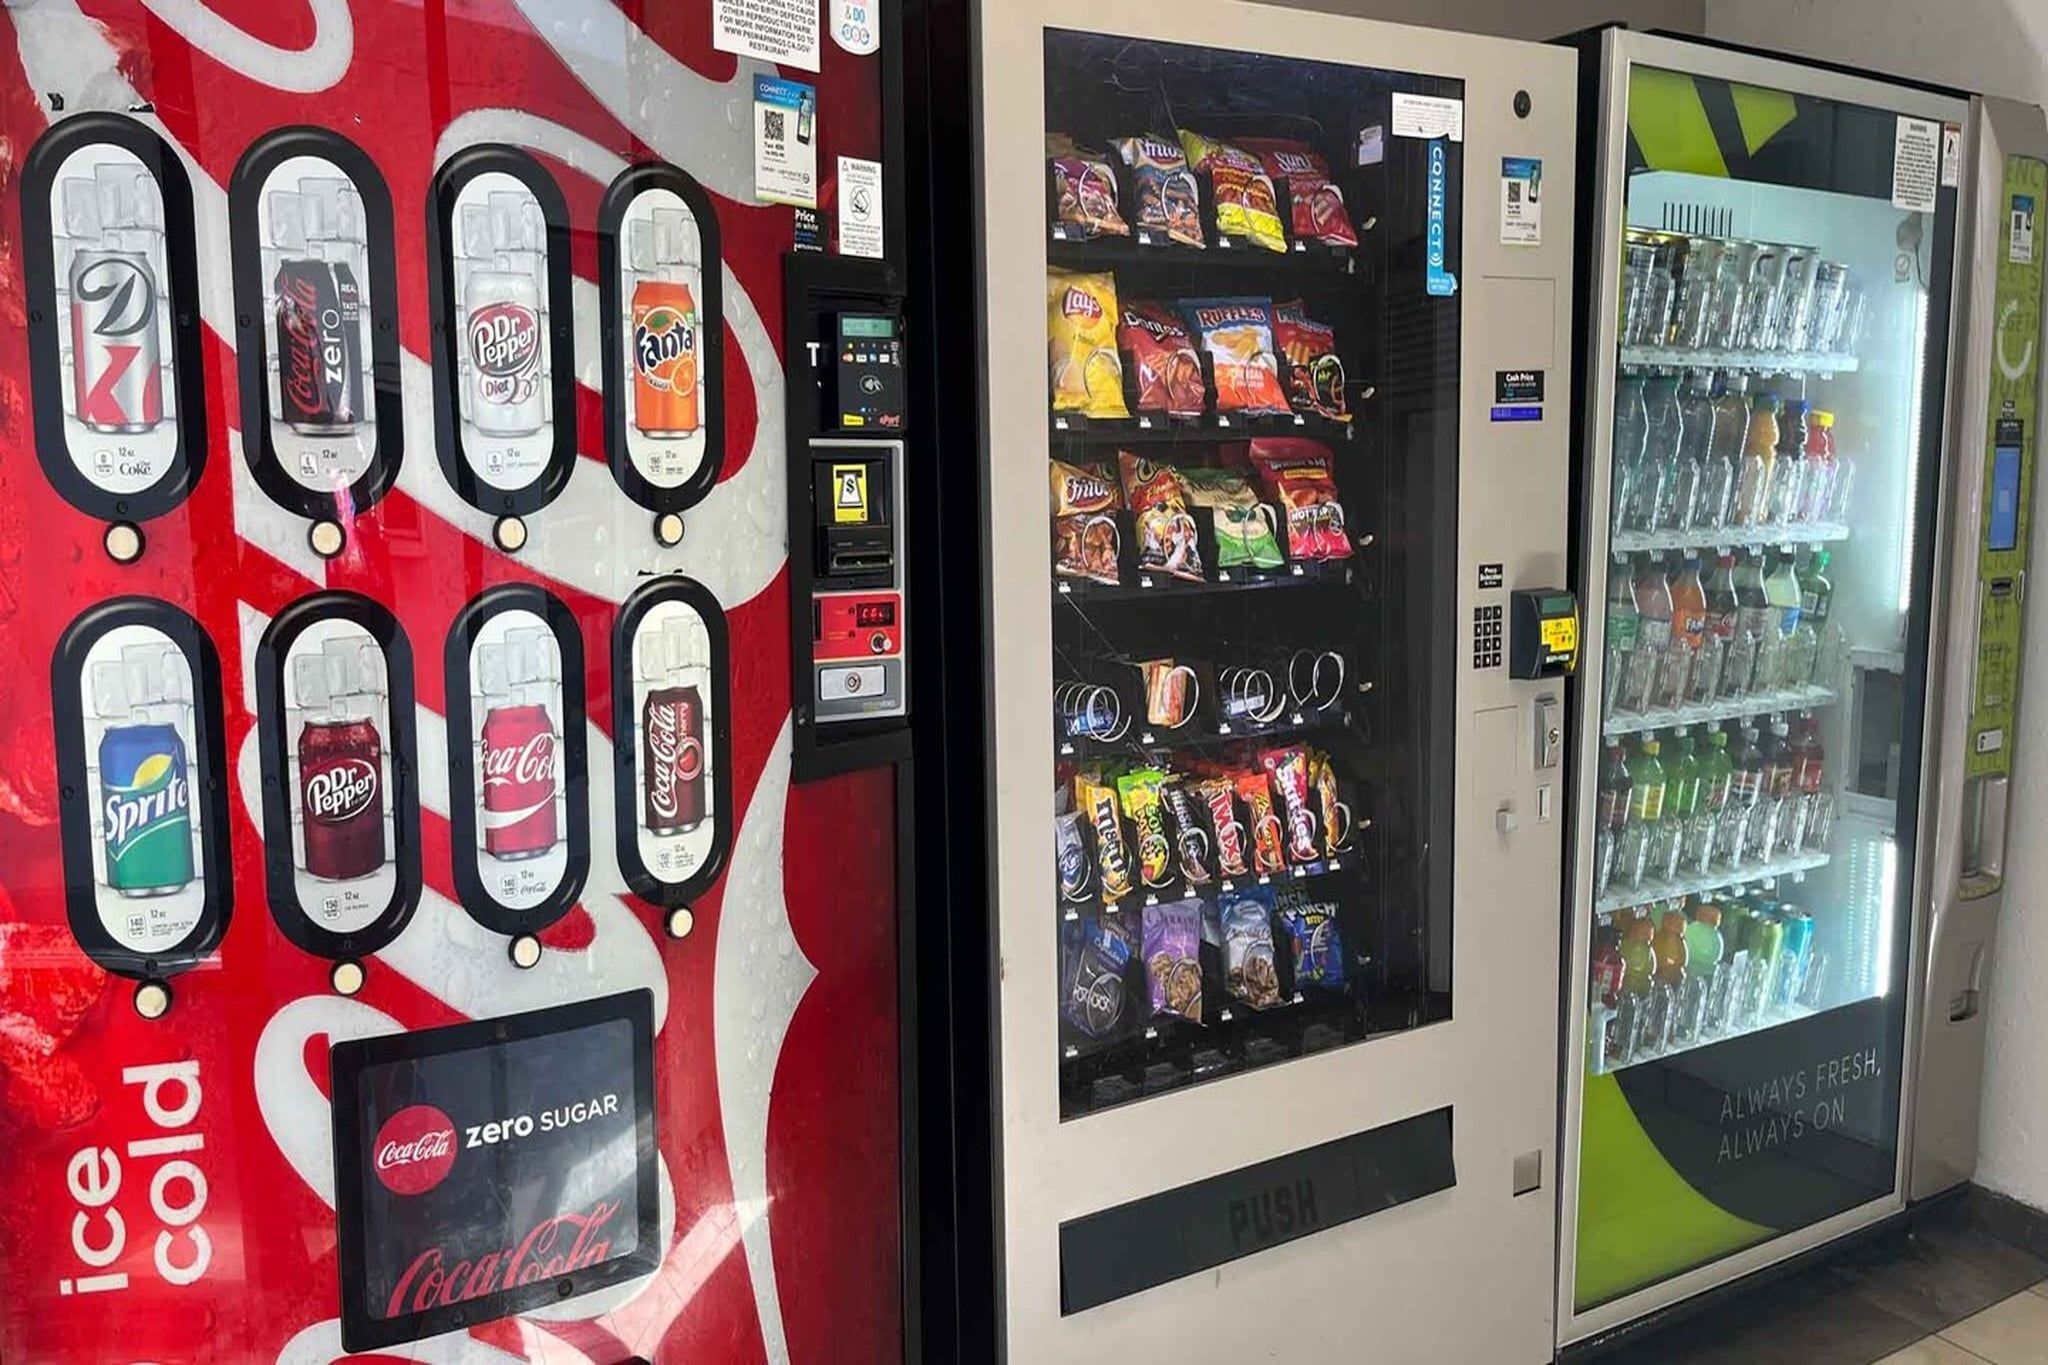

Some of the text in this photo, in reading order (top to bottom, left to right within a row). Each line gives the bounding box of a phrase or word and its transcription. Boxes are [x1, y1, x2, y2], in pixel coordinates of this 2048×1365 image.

[1431, 146, 1443, 249] CONNECT
[321, 308, 343, 385] zero
[474, 320, 535, 368] Pepper
[493, 314, 522, 340] Dr
[635, 321, 694, 374] Fanta
[485, 378, 510, 396] Diet
[312, 772, 373, 817] Pepper
[330, 766, 358, 790] Dr
[648, 701, 678, 819] Coca-Cola
[105, 771, 189, 846] Sprite
[1719, 1047, 1882, 1125] ALWAYS FRESH,
[377, 1128, 454, 1170] Coca-Cola
[465, 1093, 619, 1150] zero SUGAR
[1717, 1095, 1846, 1165] ALWAYS ON
[122, 1059, 212, 1286] cold
[59, 1146, 129, 1296] ice
[1229, 1177, 1321, 1245] PUSH
[385, 1199, 623, 1319] Coca-Cola
